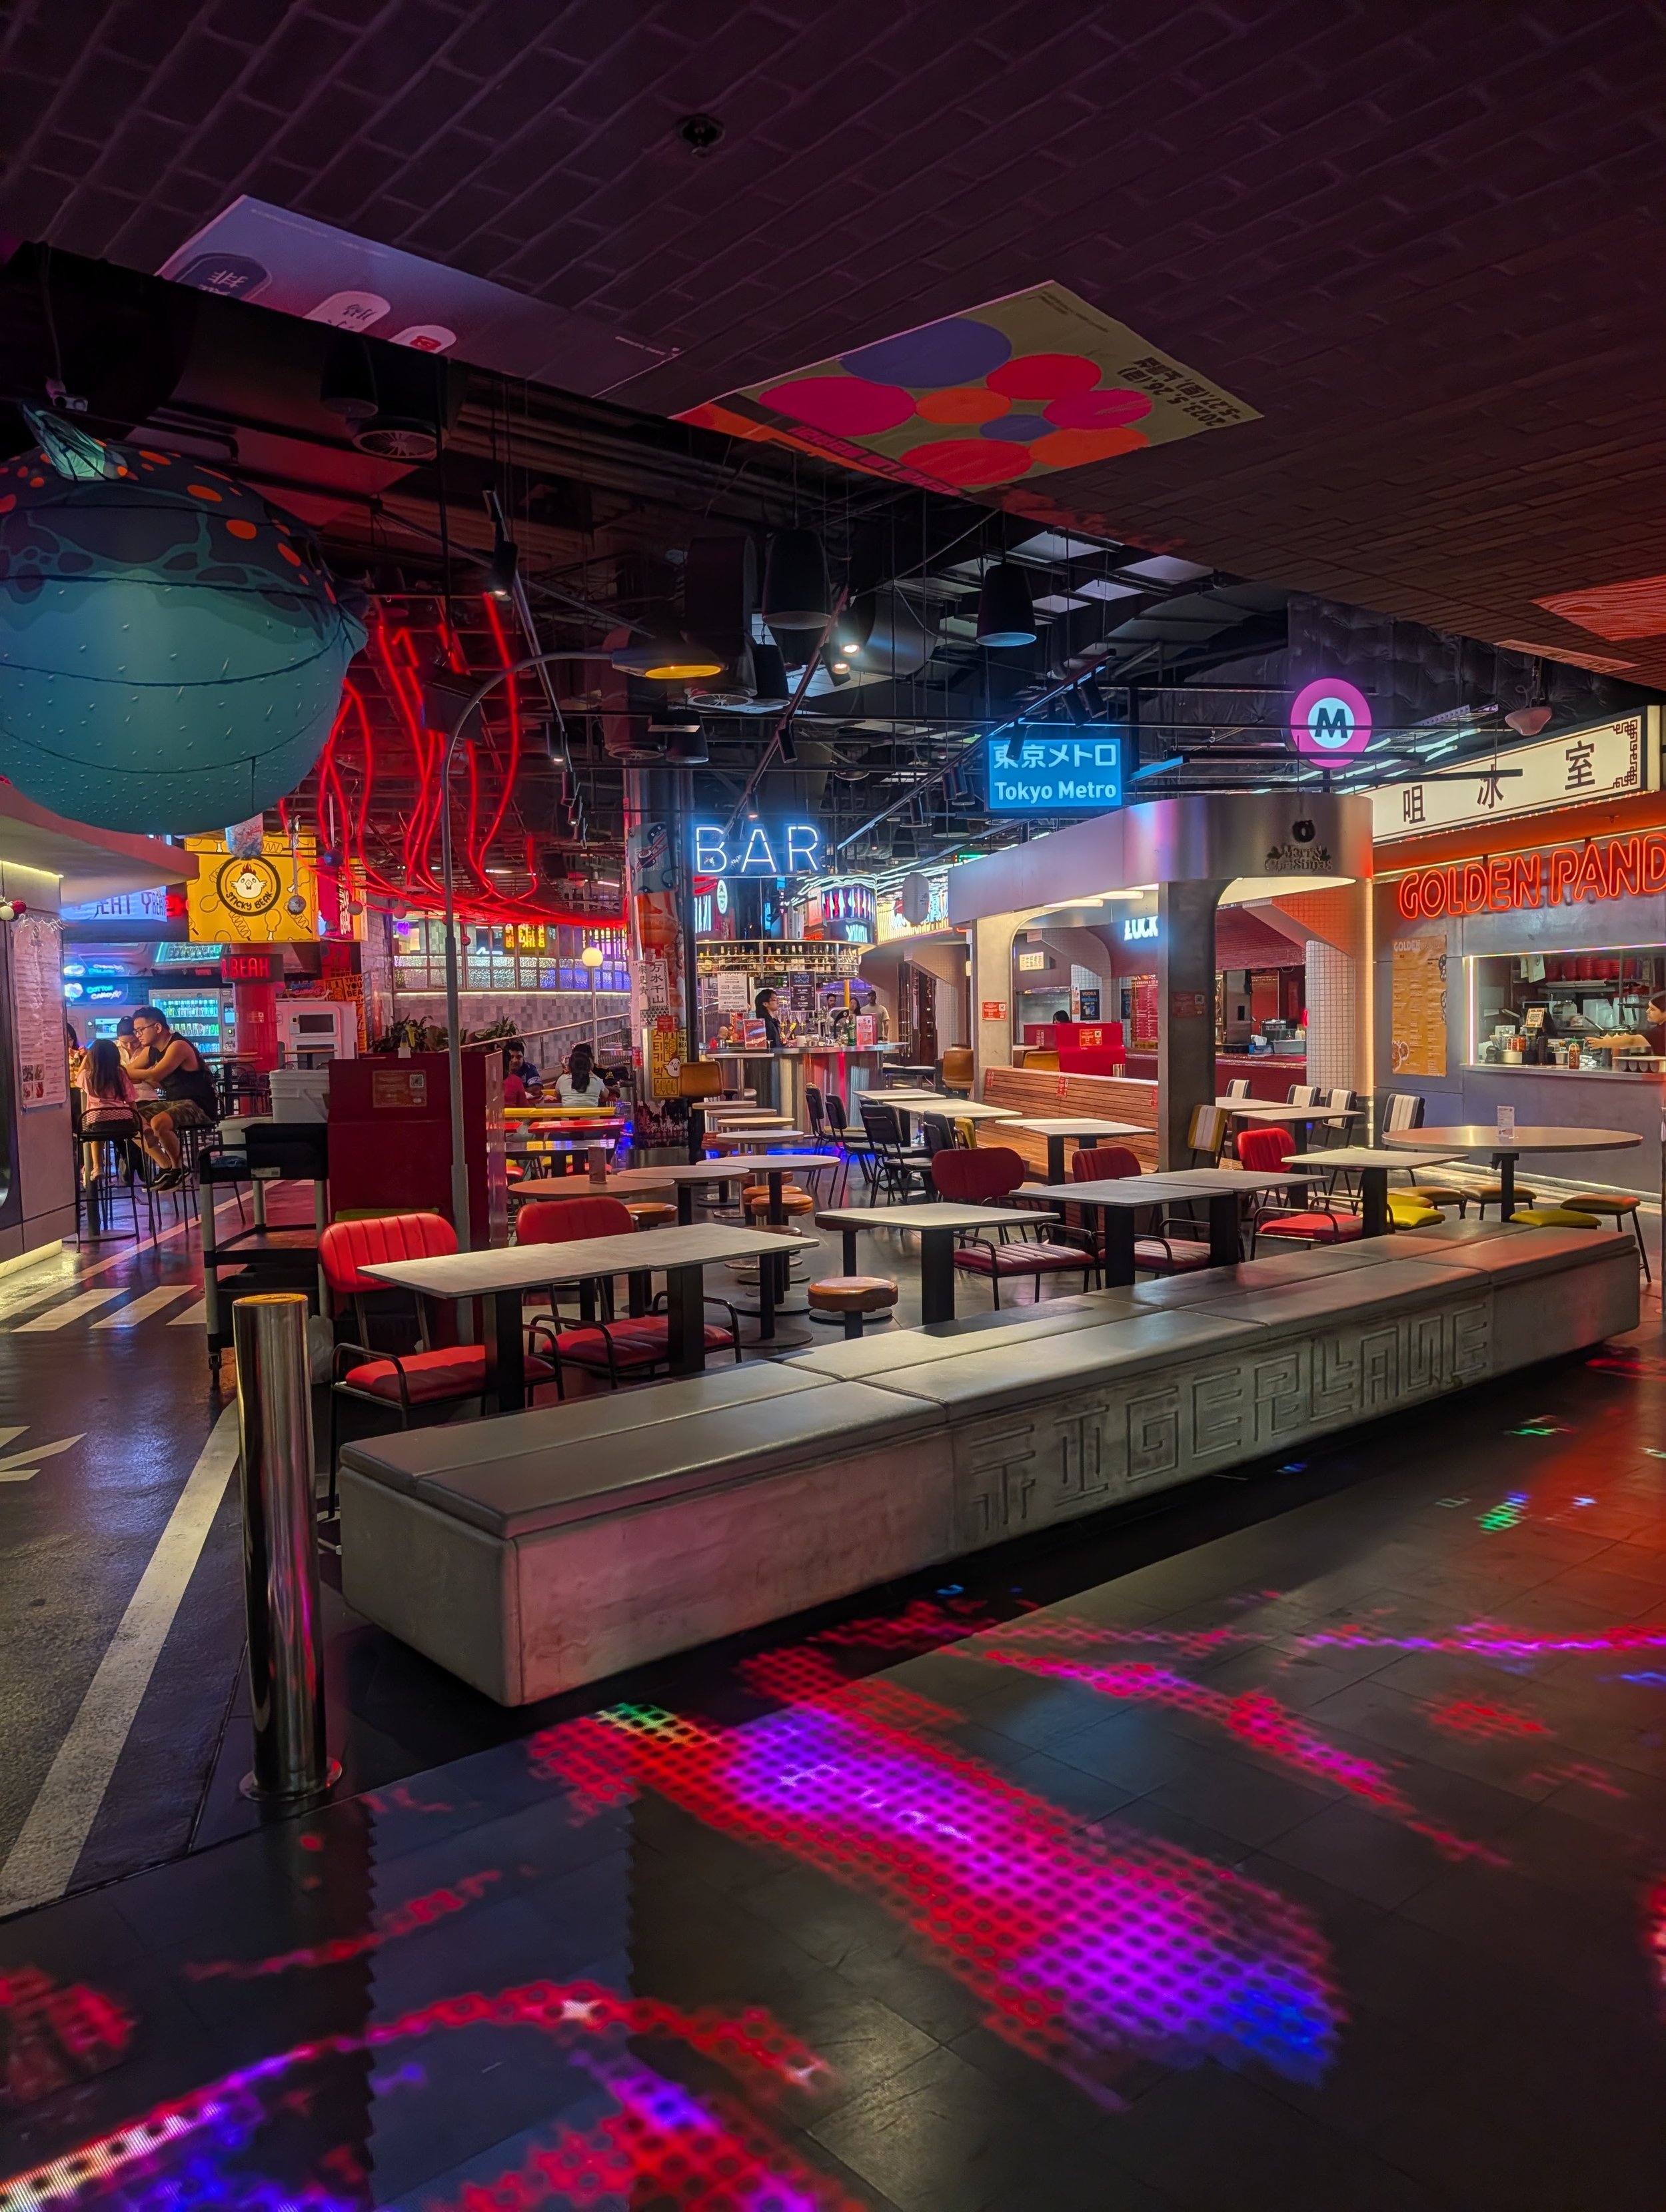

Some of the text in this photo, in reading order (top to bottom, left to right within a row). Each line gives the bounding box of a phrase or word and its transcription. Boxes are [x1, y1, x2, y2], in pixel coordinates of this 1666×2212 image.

[1315, 708, 1347, 738] M
[994, 744, 1117, 769] 東京メトロ
[994, 780, 1117, 804] Tokyo Metro
[696, 826, 819, 873] BAR
[1400, 834, 1666, 919] GOLDEN PAND
[226, 891, 273, 911] STICKY BEAK
[1394, 940, 1420, 951] GOLDEN
[650, 964, 664, 1003] 万水千山
